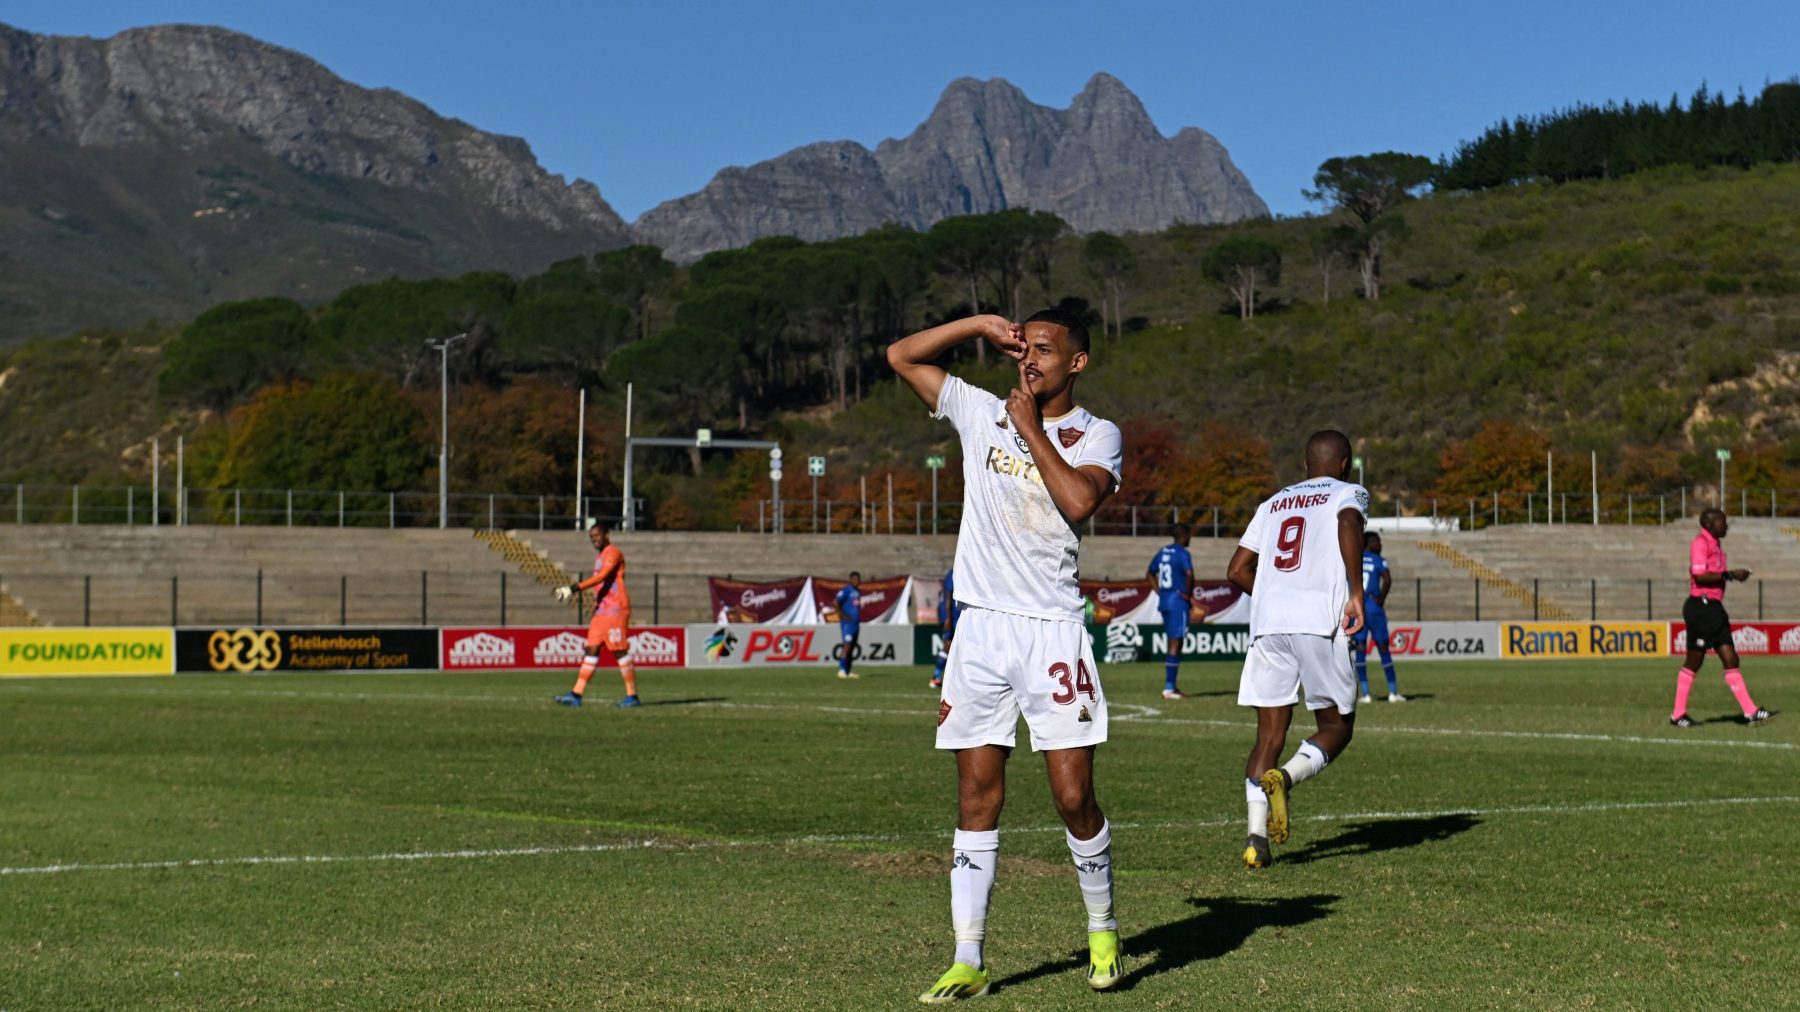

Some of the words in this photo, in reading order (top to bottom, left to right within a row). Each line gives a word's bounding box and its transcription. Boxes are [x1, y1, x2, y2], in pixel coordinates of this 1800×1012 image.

[986, 446, 1041, 481] Ram
[1270, 494, 1330, 514] RAYNERS
[1274, 516, 1306, 572] 9
[1159, 563, 1172, 589] 13
[8, 642, 164, 661] FOUNDATION
[289, 635, 381, 650] Stellenbosch
[450, 631, 514, 655] JONSSON
[1509, 625, 1578, 656] Rama
[1590, 624, 1657, 654] Rama
[289, 653, 352, 669] Academy
[355, 653, 370, 667] of
[373, 653, 409, 669] Sport
[1048, 658, 1096, 705] 34
